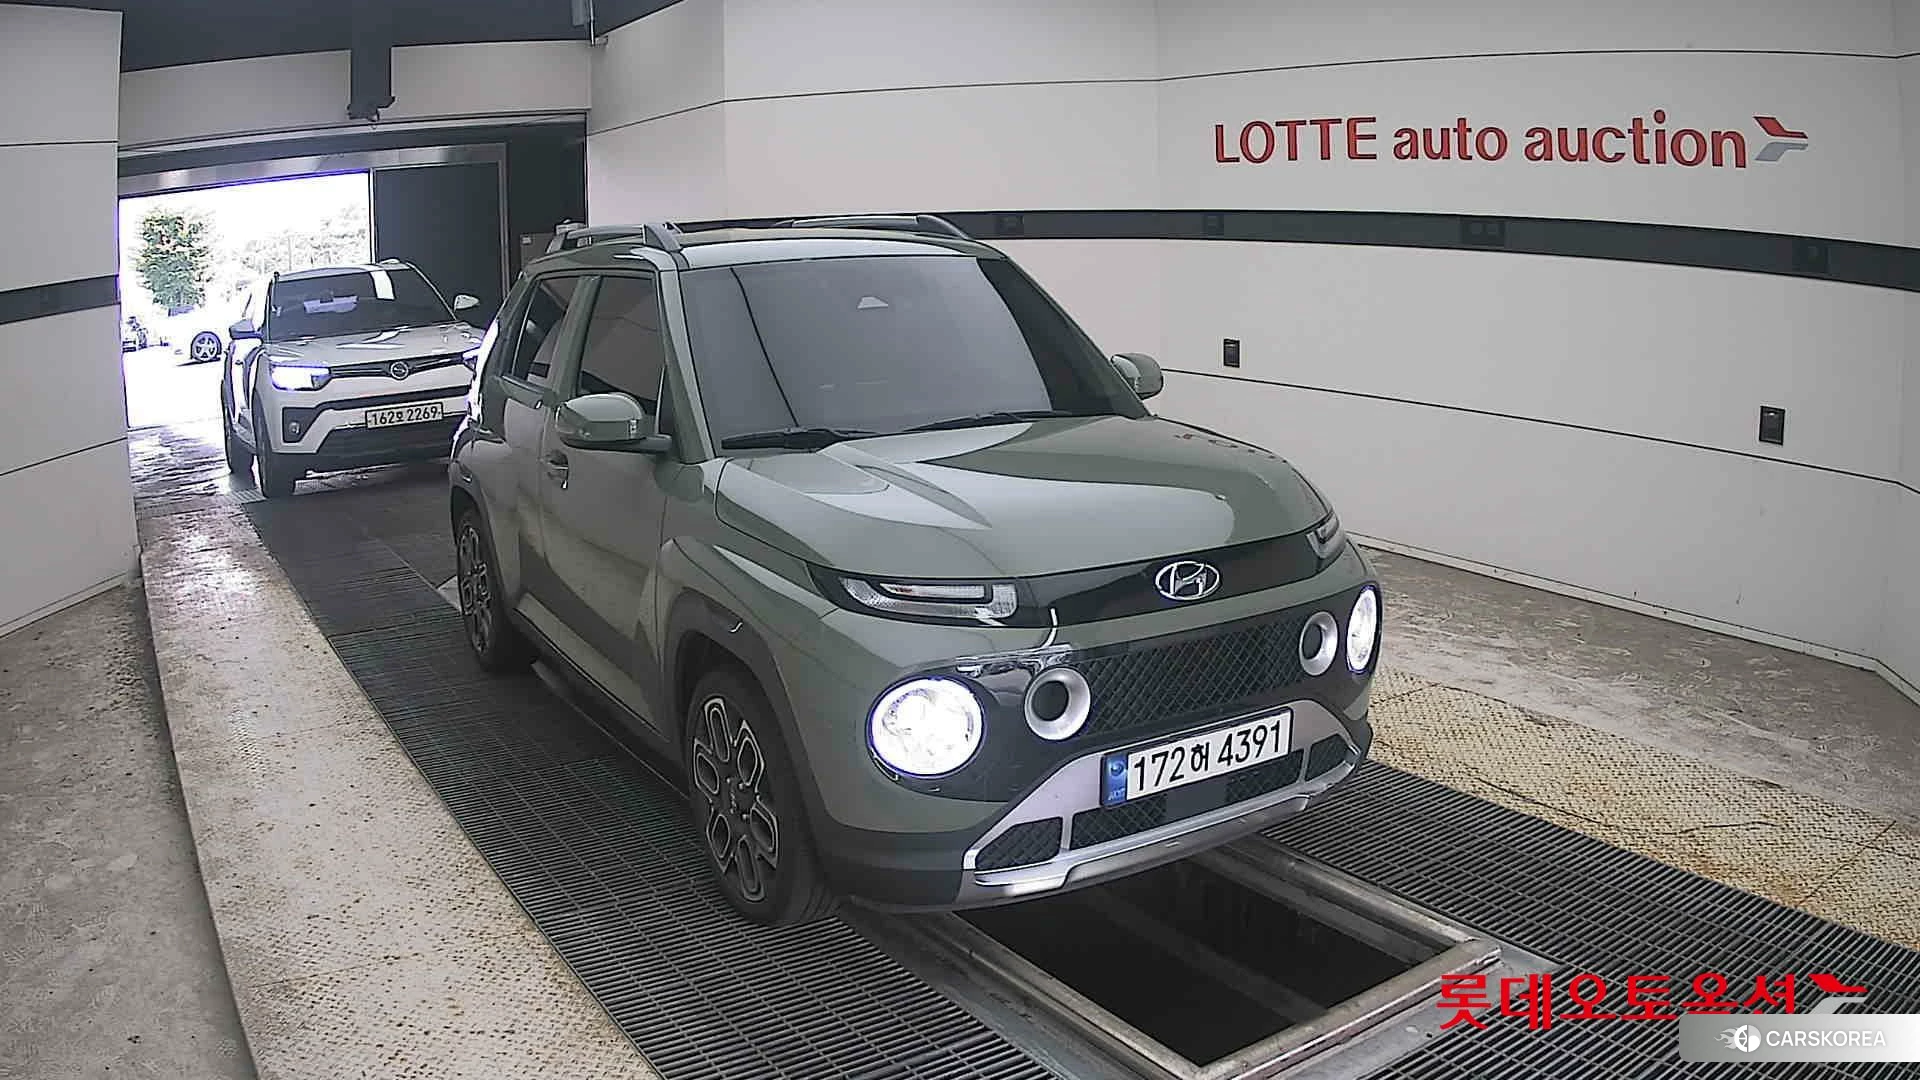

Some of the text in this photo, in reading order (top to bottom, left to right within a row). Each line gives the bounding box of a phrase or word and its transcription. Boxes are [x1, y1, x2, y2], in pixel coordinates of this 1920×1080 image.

[1215, 110, 1747, 169] LOTTE auto auction
[407, 406, 438, 421] 2269
[1134, 720, 1281, 791] 172허 4391
